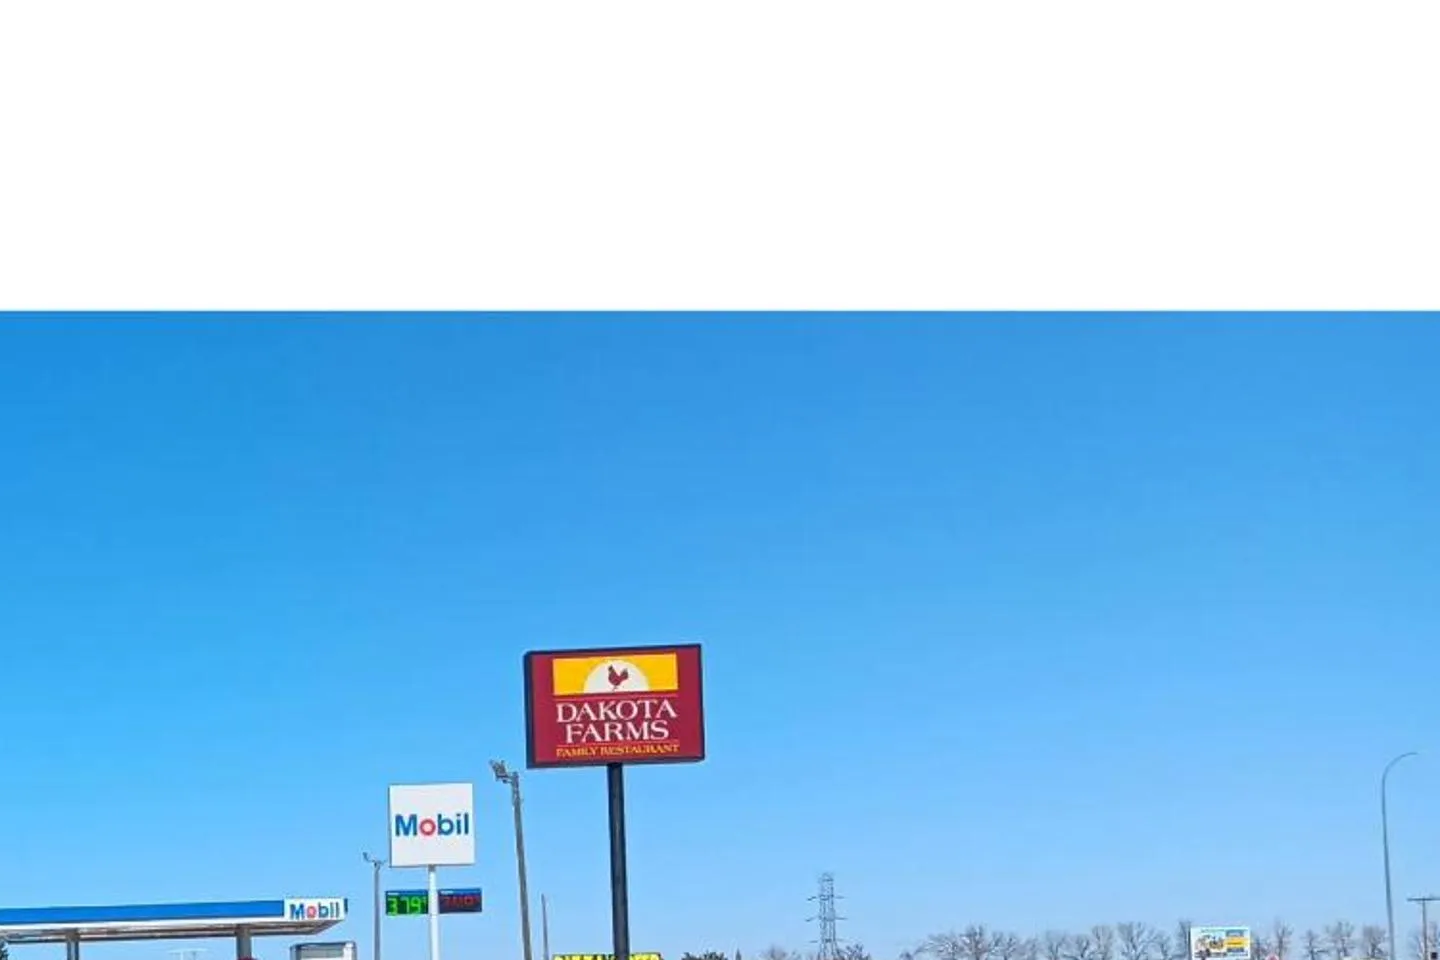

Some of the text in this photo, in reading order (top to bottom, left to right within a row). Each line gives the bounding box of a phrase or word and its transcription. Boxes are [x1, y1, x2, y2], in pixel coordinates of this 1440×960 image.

[556, 700, 677, 723] DAKOTA
[565, 720, 669, 744] FARMS
[556, 744, 680, 757] FAMILY RESTAURANT
[395, 813, 469, 837] Mobil
[290, 901, 340, 920] Mobil
